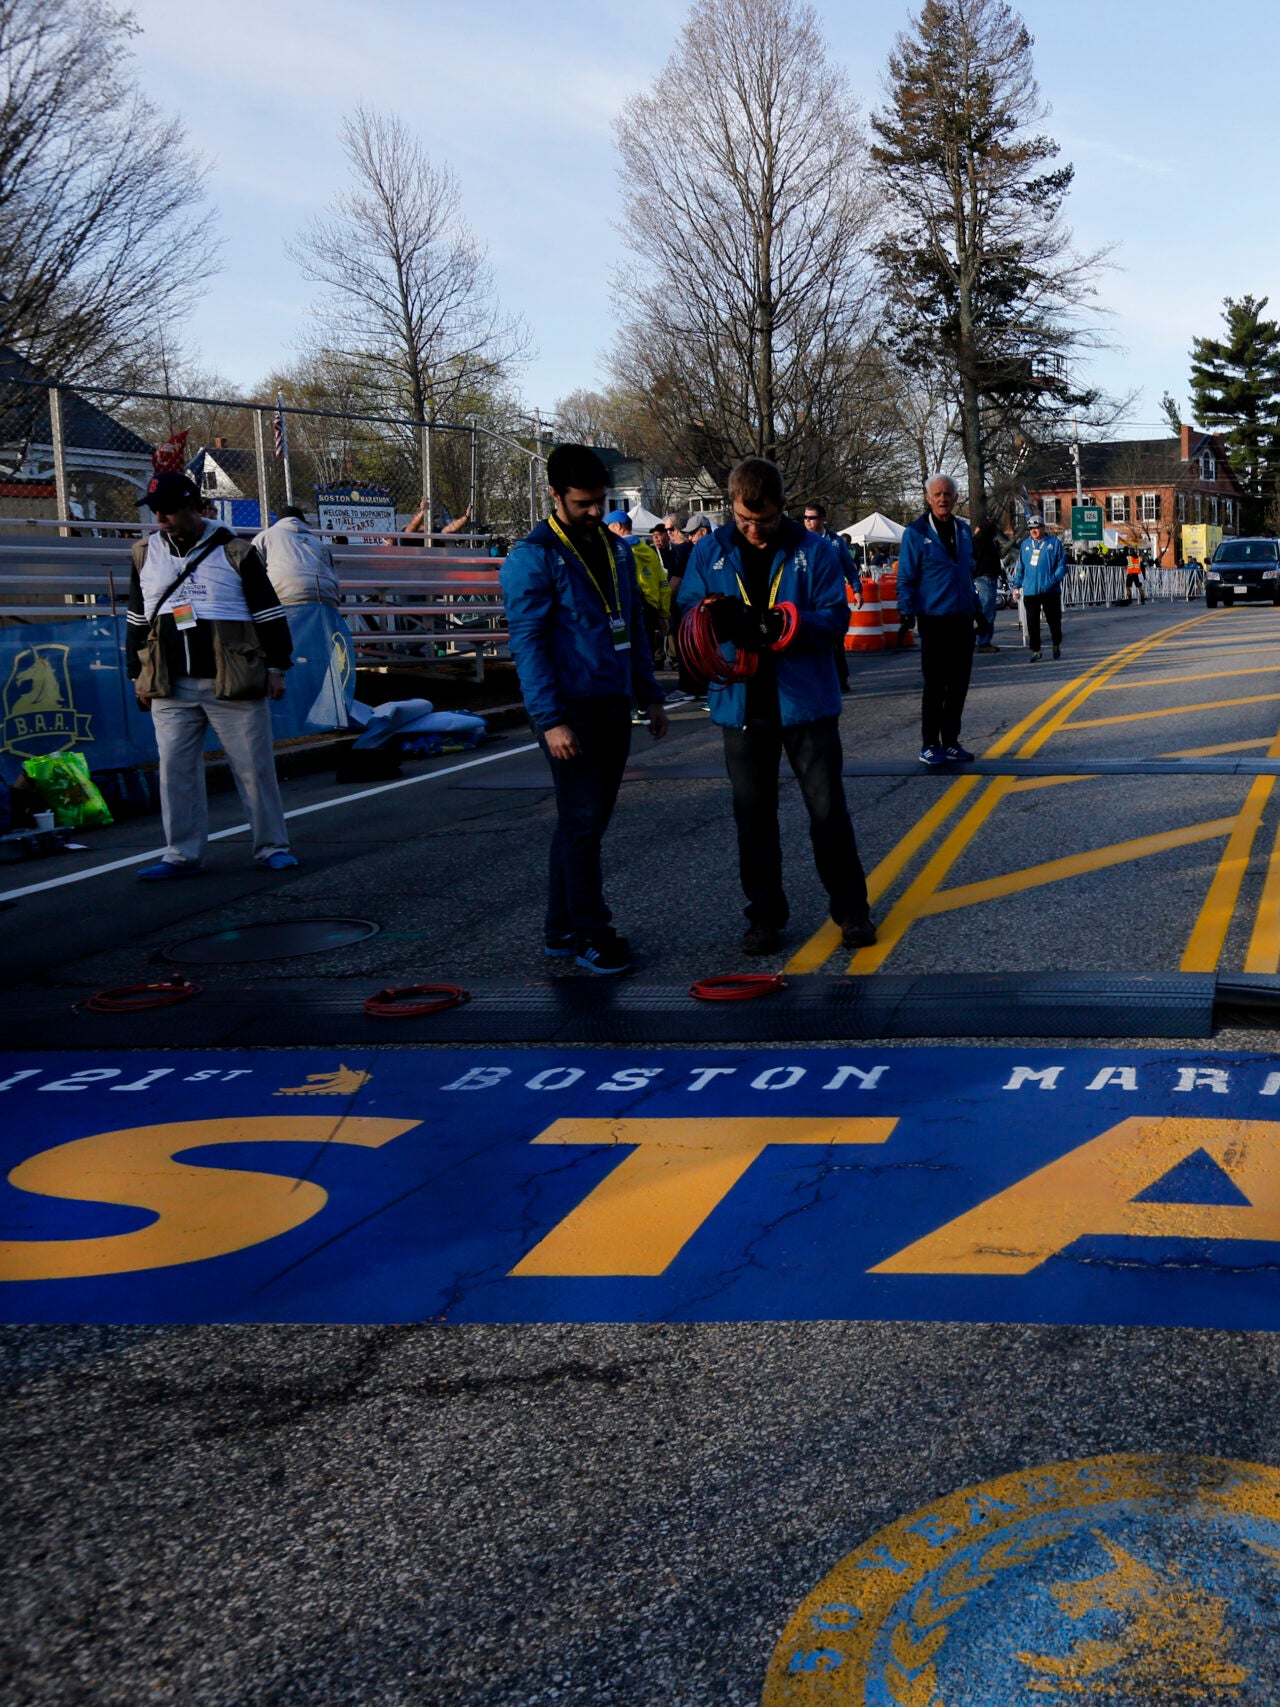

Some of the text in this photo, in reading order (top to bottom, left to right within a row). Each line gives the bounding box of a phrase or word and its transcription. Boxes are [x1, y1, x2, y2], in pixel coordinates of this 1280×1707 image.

[148, 478, 159, 493] B
[318, 494, 390, 504] BOSTON MARATHON
[323, 508, 350, 518] WELCOME
[351, 509, 359, 517] TO
[15, 712, 69, 736] B.A.A.
[440, 1065, 890, 1092] BOSTON
[788, 1602, 863, 1672] 50
[855, 1465, 1113, 1575] YEARS
